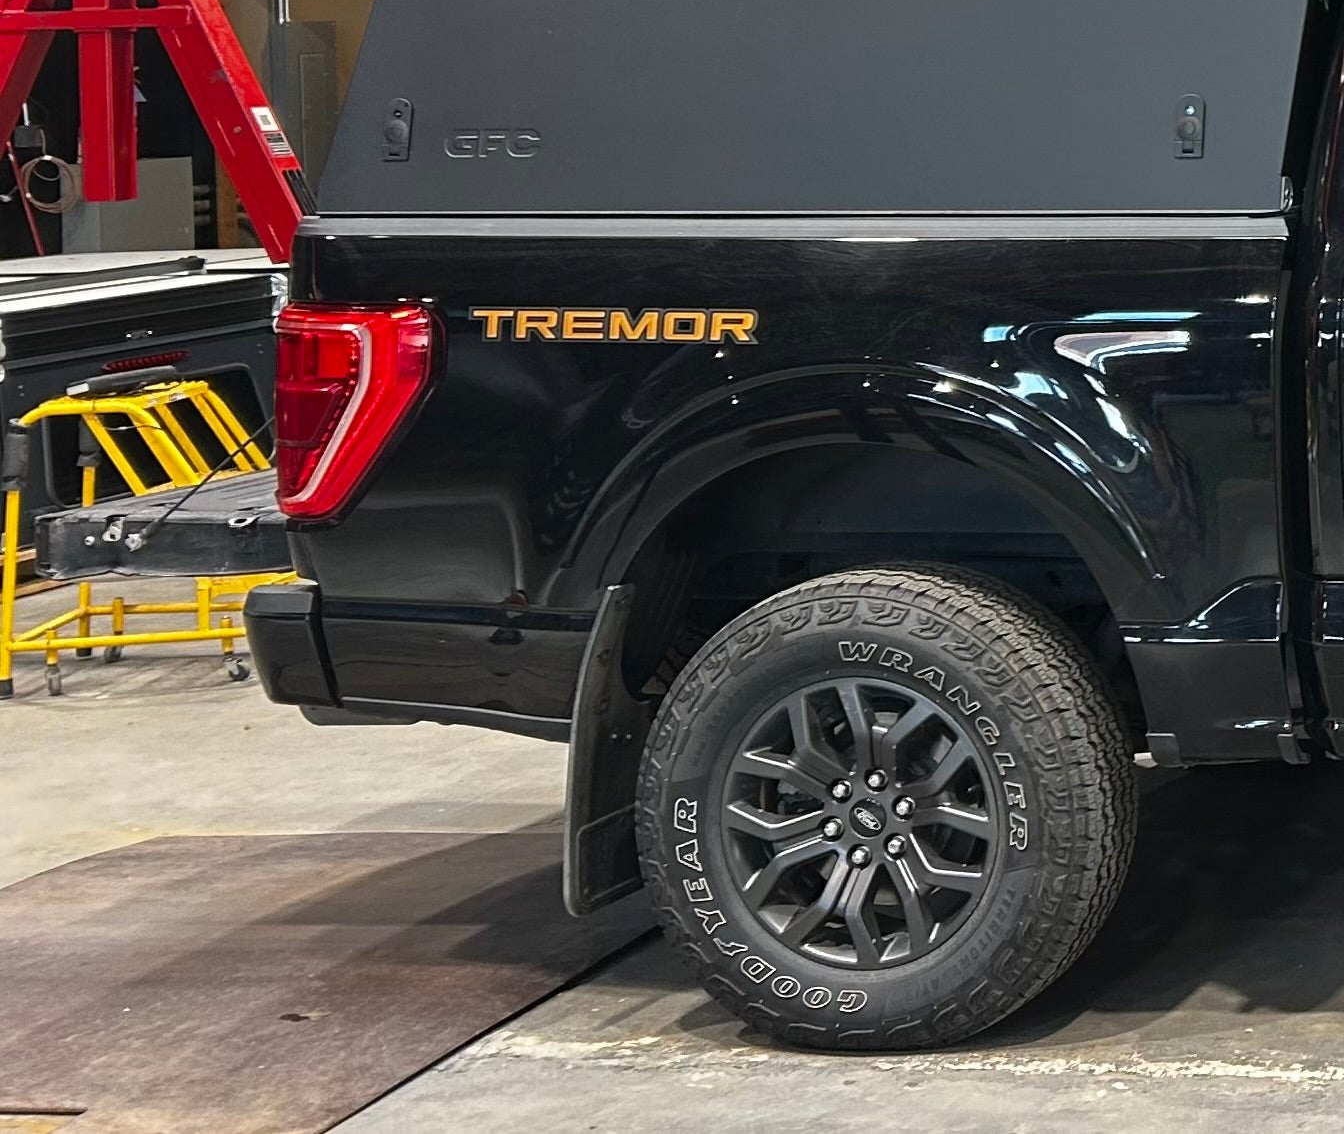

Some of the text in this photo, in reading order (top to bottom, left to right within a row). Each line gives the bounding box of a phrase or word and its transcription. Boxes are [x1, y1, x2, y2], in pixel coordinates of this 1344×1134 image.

[444, 128, 540, 158] GFC
[471, 309, 756, 342] TREMOR
[838, 640, 1029, 852] WRANGLER
[673, 797, 869, 1013] GOODYEAR
[937, 886, 1022, 983] TERRITOR
